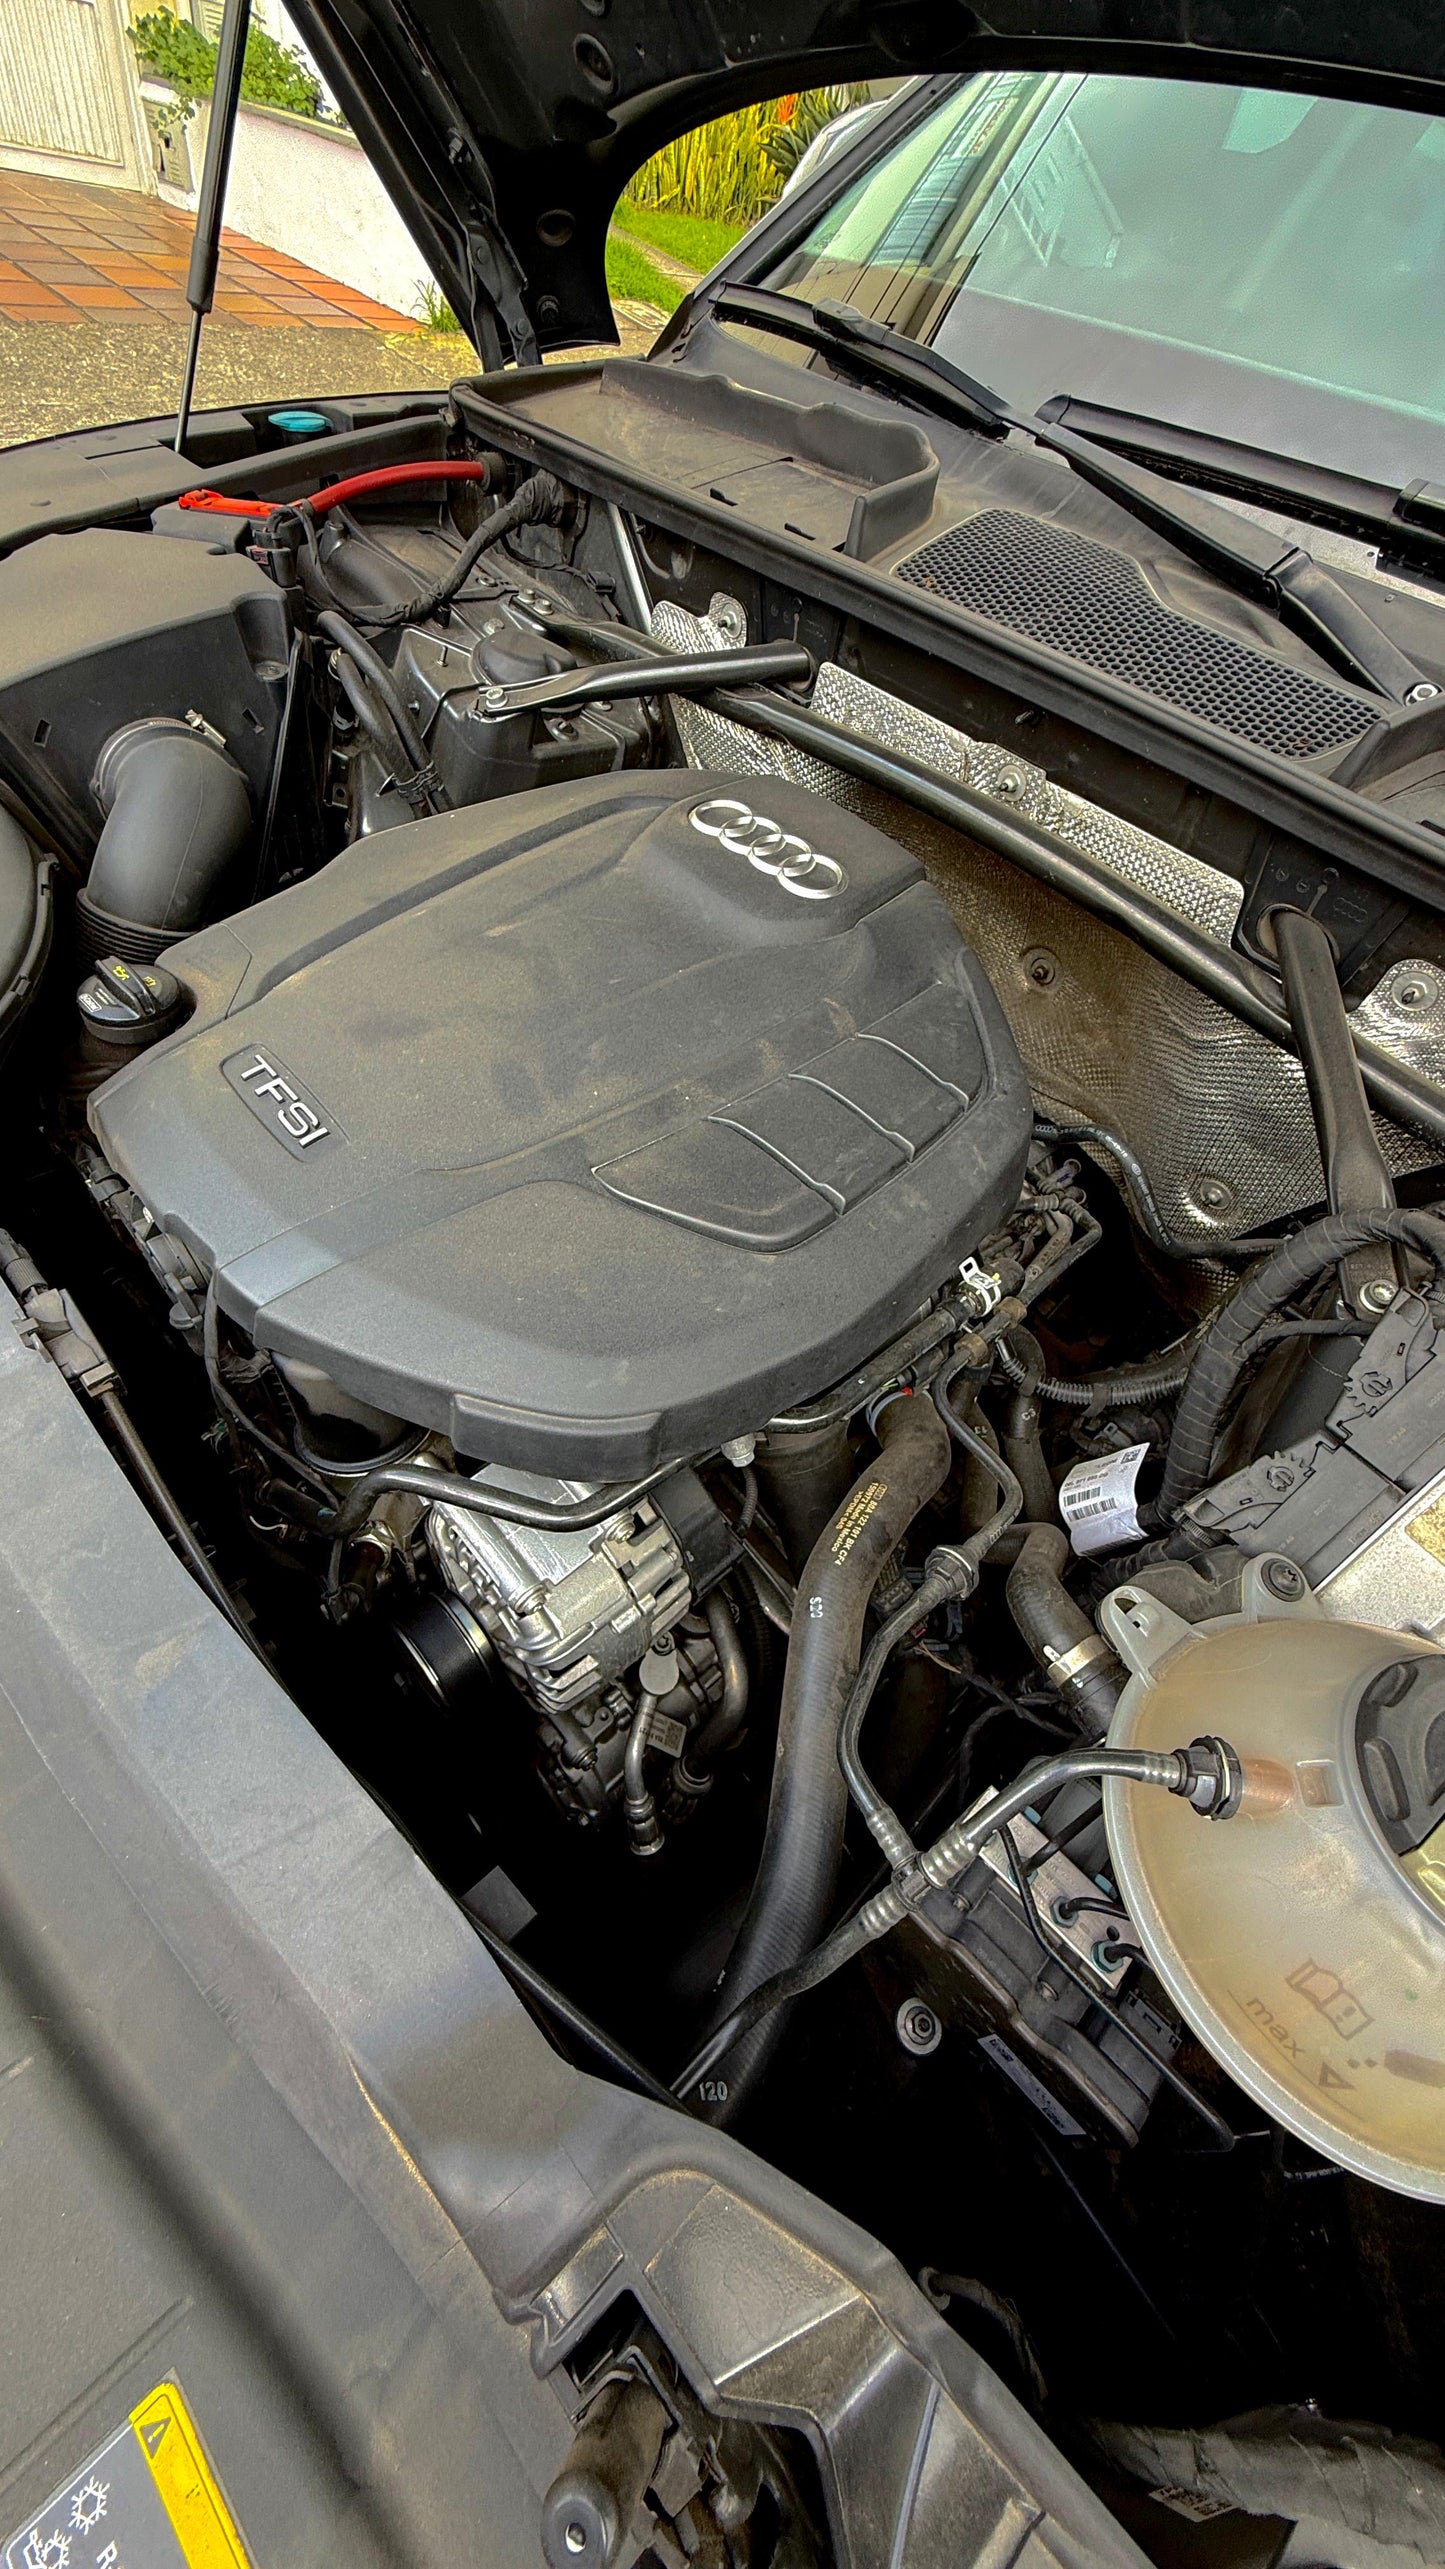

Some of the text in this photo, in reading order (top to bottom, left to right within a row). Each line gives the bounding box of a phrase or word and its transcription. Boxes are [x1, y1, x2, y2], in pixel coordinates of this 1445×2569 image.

[241, 1054, 329, 1148] TFSI
[850, 1503, 866, 1520] Made
[857, 1514, 869, 1526] 122
[846, 1519, 855, 1528] in
[850, 1526, 862, 1538] 101
[831, 1528, 851, 1552] Mexico
[843, 1537, 855, 1551] BK
[1246, 1999, 1306, 2059] max
[699, 2081, 728, 2101] 120
